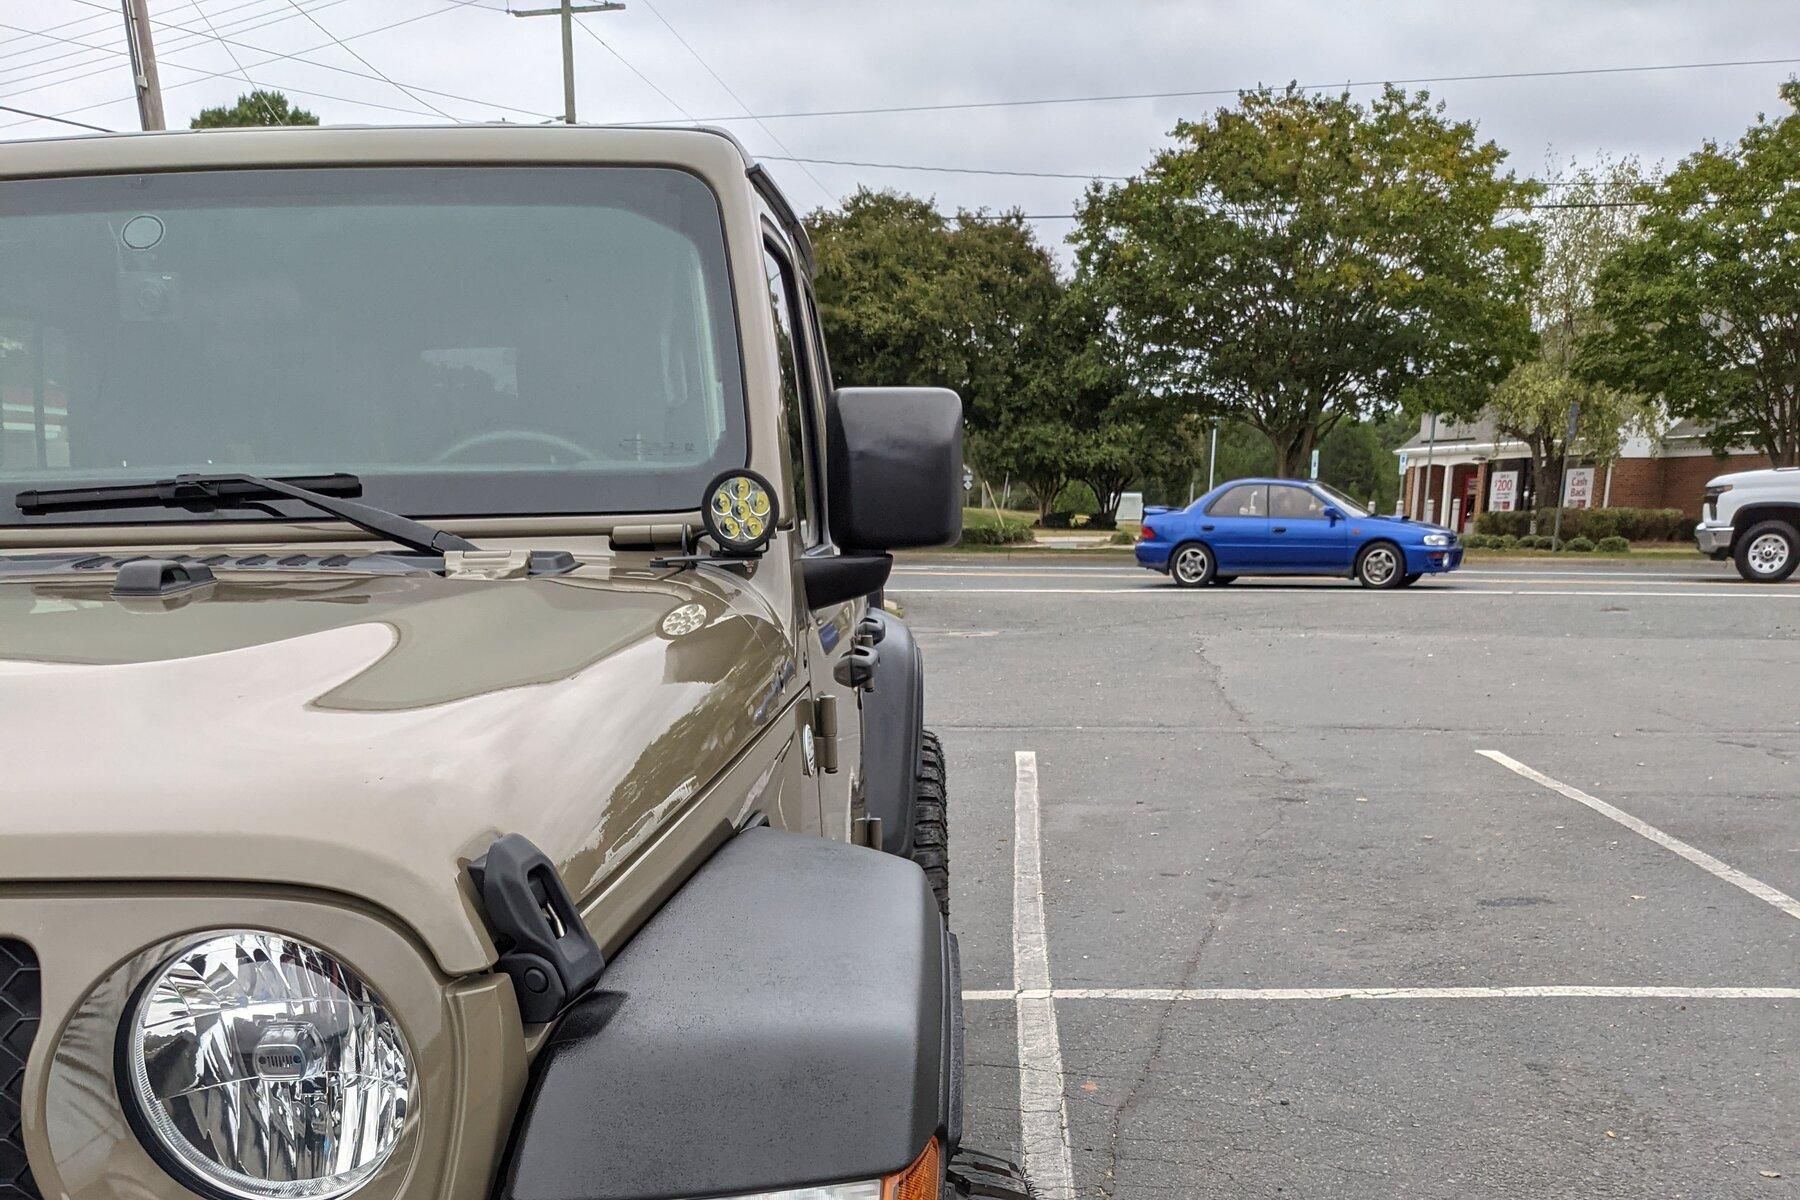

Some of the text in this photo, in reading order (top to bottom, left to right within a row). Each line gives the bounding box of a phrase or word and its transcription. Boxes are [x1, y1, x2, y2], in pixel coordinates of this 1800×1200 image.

[1494, 479, 1512, 491] $200
[1571, 477, 1588, 487] Cash
[1570, 487, 1585, 497] Back
